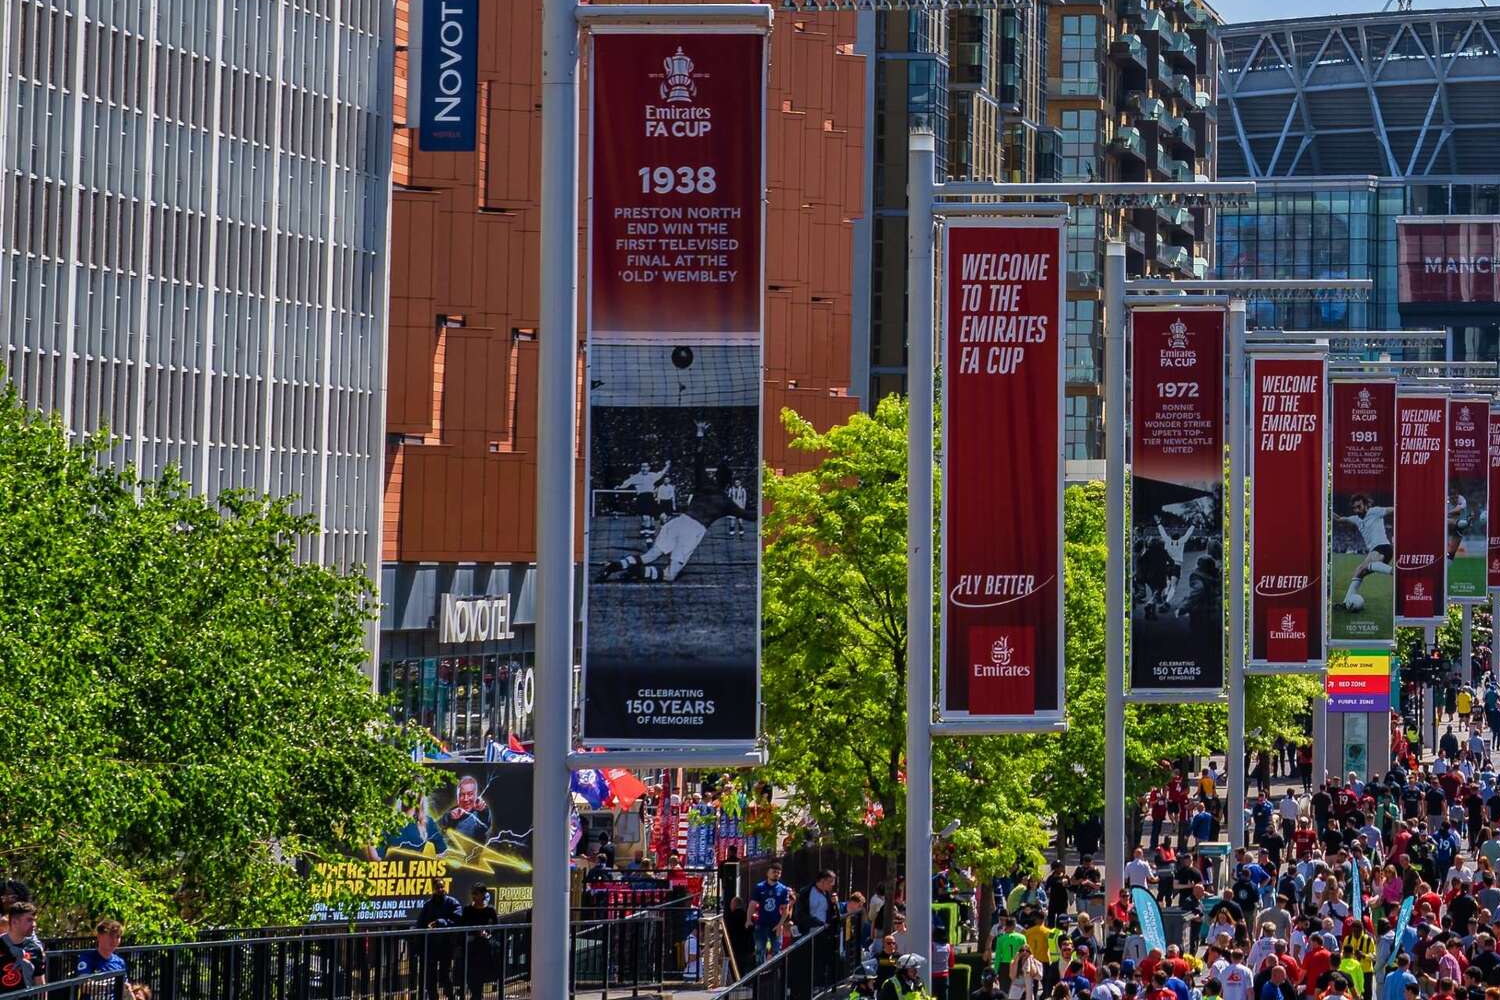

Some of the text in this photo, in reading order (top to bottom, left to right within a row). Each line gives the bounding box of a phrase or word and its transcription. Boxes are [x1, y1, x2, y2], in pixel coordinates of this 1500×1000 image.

[645, 105, 711, 119] Emirates
[645, 121, 711, 137] FA CUP
[638, 167, 716, 194] 1938
[614, 207, 741, 219] PRESTON NORTH
[627, 223, 727, 235] END WIN THE
[616, 239, 738, 250] FIRST TELEVISED
[627, 255, 727, 266] FINAL AT THE
[962, 253, 1050, 281] WELCOME
[663, 271, 738, 282] WEMBLEY
[962, 284, 1022, 312] TO THE
[960, 316, 1048, 342] EMIRATES
[960, 347, 1024, 374] FA CUP
[1161, 359, 1196, 367] FA CUP
[1157, 383, 1199, 397] 1972
[1263, 376, 1318, 392] WELCOME
[1262, 395, 1300, 412] TO THE
[1401, 410, 1442, 422] WELCOME
[1261, 415, 1316, 431] EMIRATES
[1401, 424, 1429, 436] TO THE
[1261, 434, 1301, 451] FA CUP
[1351, 431, 1377, 442] 1981
[1401, 438, 1440, 450] EMIRATES
[1454, 439, 1475, 447] 1991
[1401, 452, 1410, 464] FA
[1413, 452, 1430, 464] CUP
[1400, 555, 1434, 564] FLY BETTER
[958, 575, 1035, 595] FLY BETTER
[1261, 576, 1308, 588] FLY BETTER
[440, 593, 515, 643] NOVOTEL
[1270, 630, 1305, 639] Emirates
[974, 664, 1031, 677] Emirates
[1153, 667, 1200, 675] 150 YEARS
[638, 688, 704, 698] CELEBRATING
[626, 700, 715, 714] 150 YEARS
[636, 716, 704, 725] OF MEMORIES
[368, 861, 406, 879] REAL
[409, 860, 447, 877] FANS
[367, 878, 452, 896] BREAKFAT
[382, 901, 397, 909] AND
[399, 900, 416, 909] ALLY
